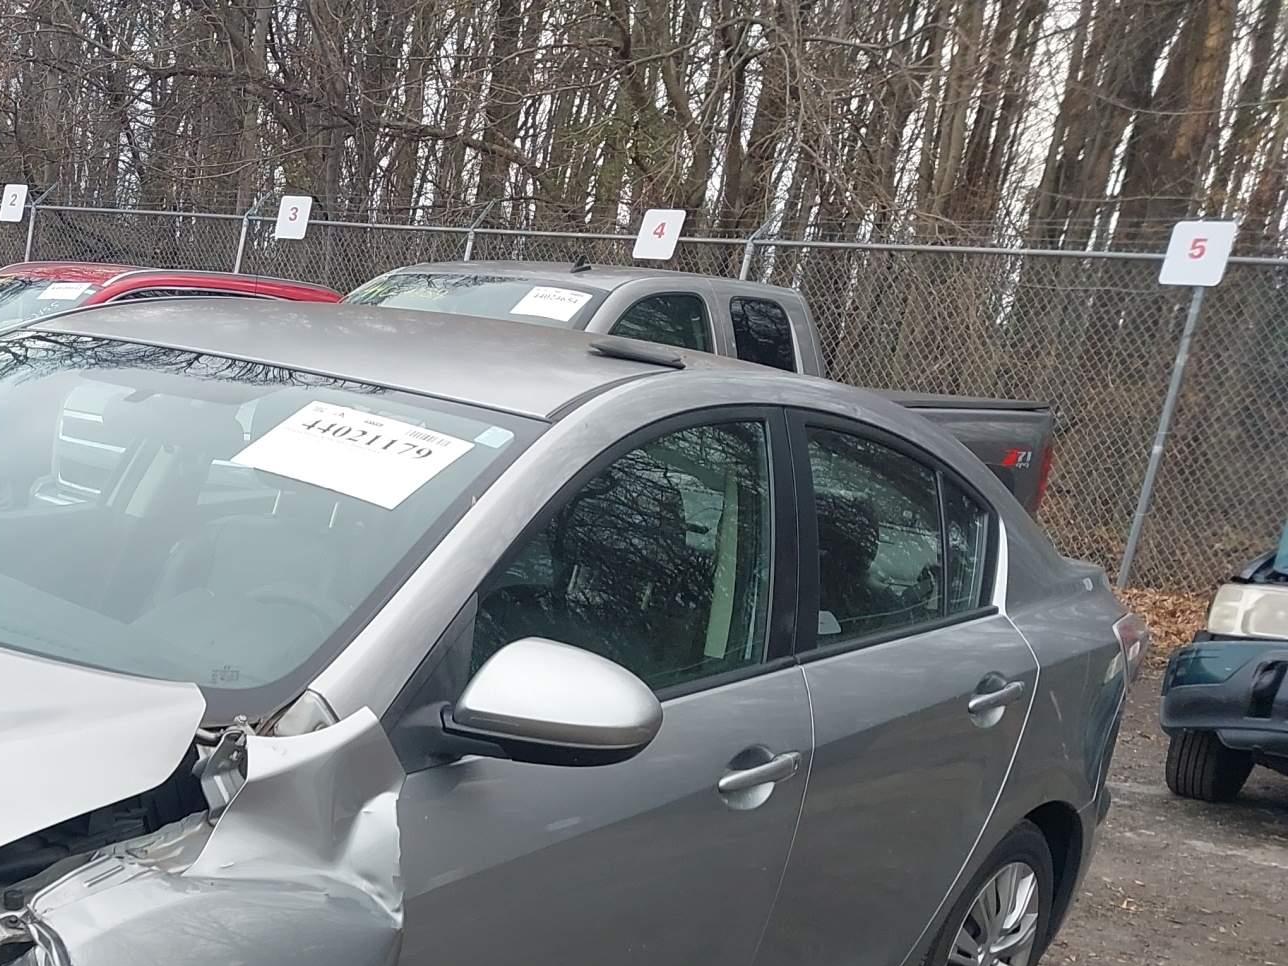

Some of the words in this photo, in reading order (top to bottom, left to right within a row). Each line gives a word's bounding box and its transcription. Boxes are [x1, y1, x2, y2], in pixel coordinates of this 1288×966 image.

[9, 193, 18, 207] 2
[288, 206, 299, 222] 3
[653, 222, 667, 239] 4
[1188, 237, 1209, 260] 5
[301, 419, 433, 460] 44021179
